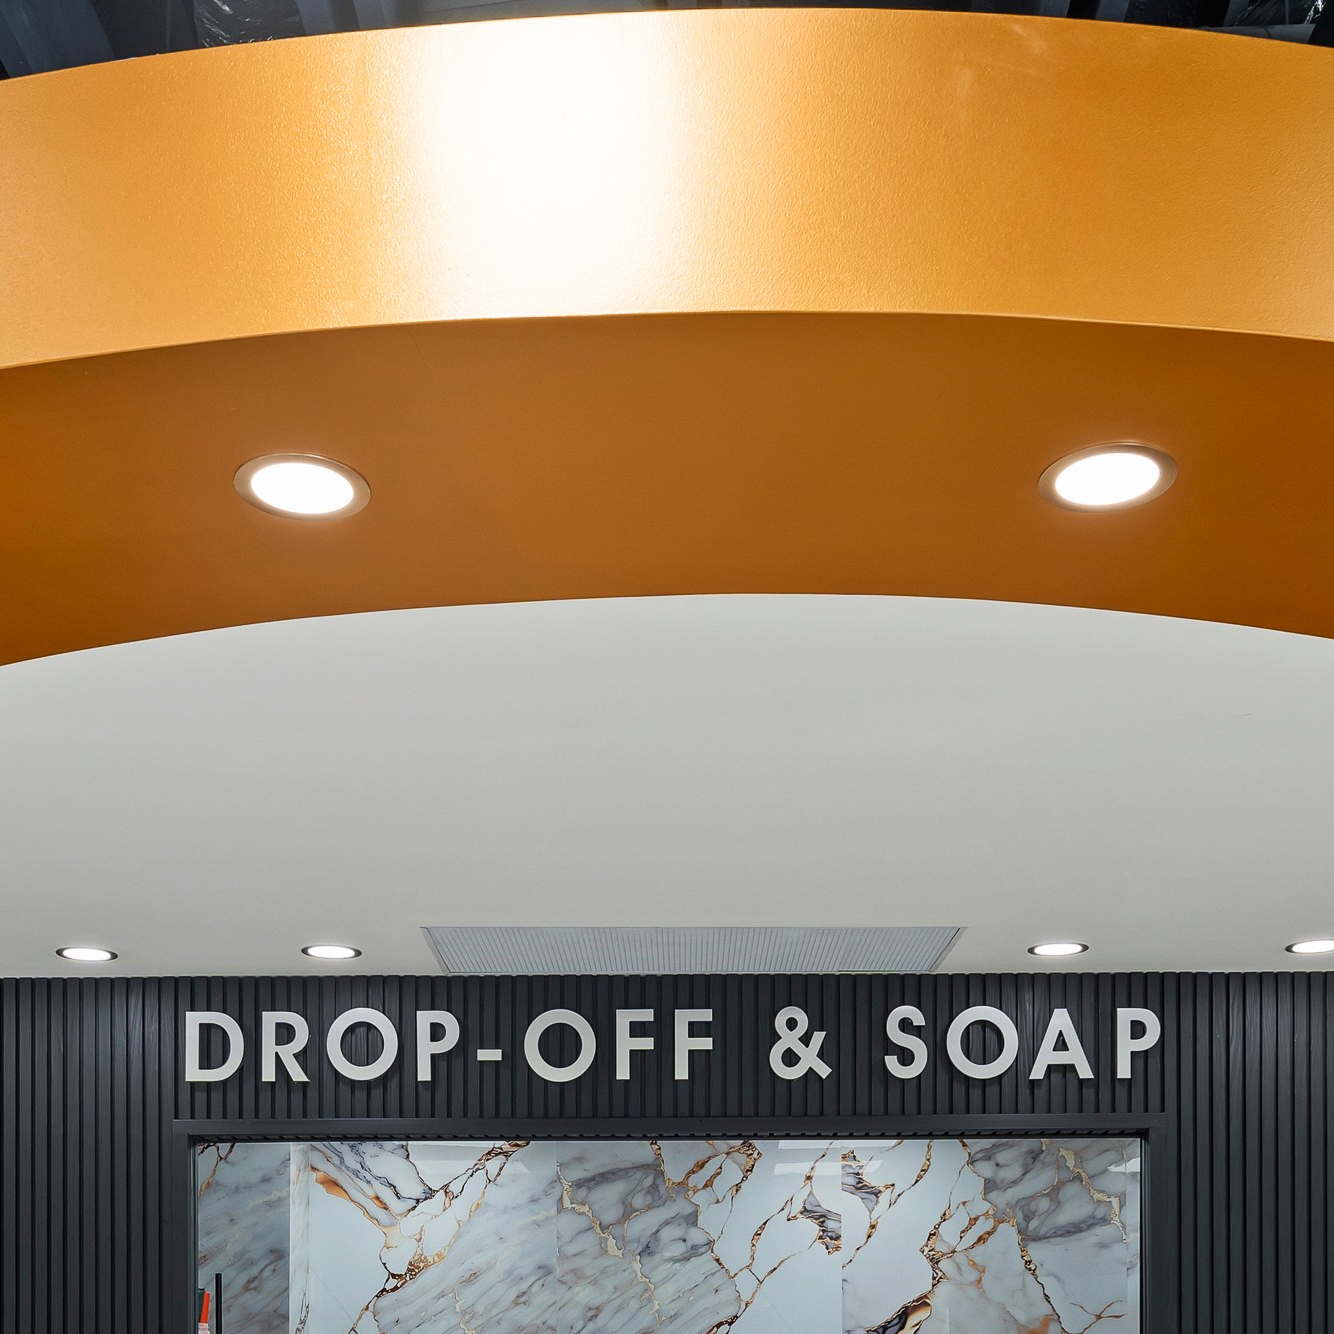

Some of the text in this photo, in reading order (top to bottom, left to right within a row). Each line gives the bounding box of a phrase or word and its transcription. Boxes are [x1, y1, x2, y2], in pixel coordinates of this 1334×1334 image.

[184, 1005, 1161, 1083] DROP-OFF & SOAP
